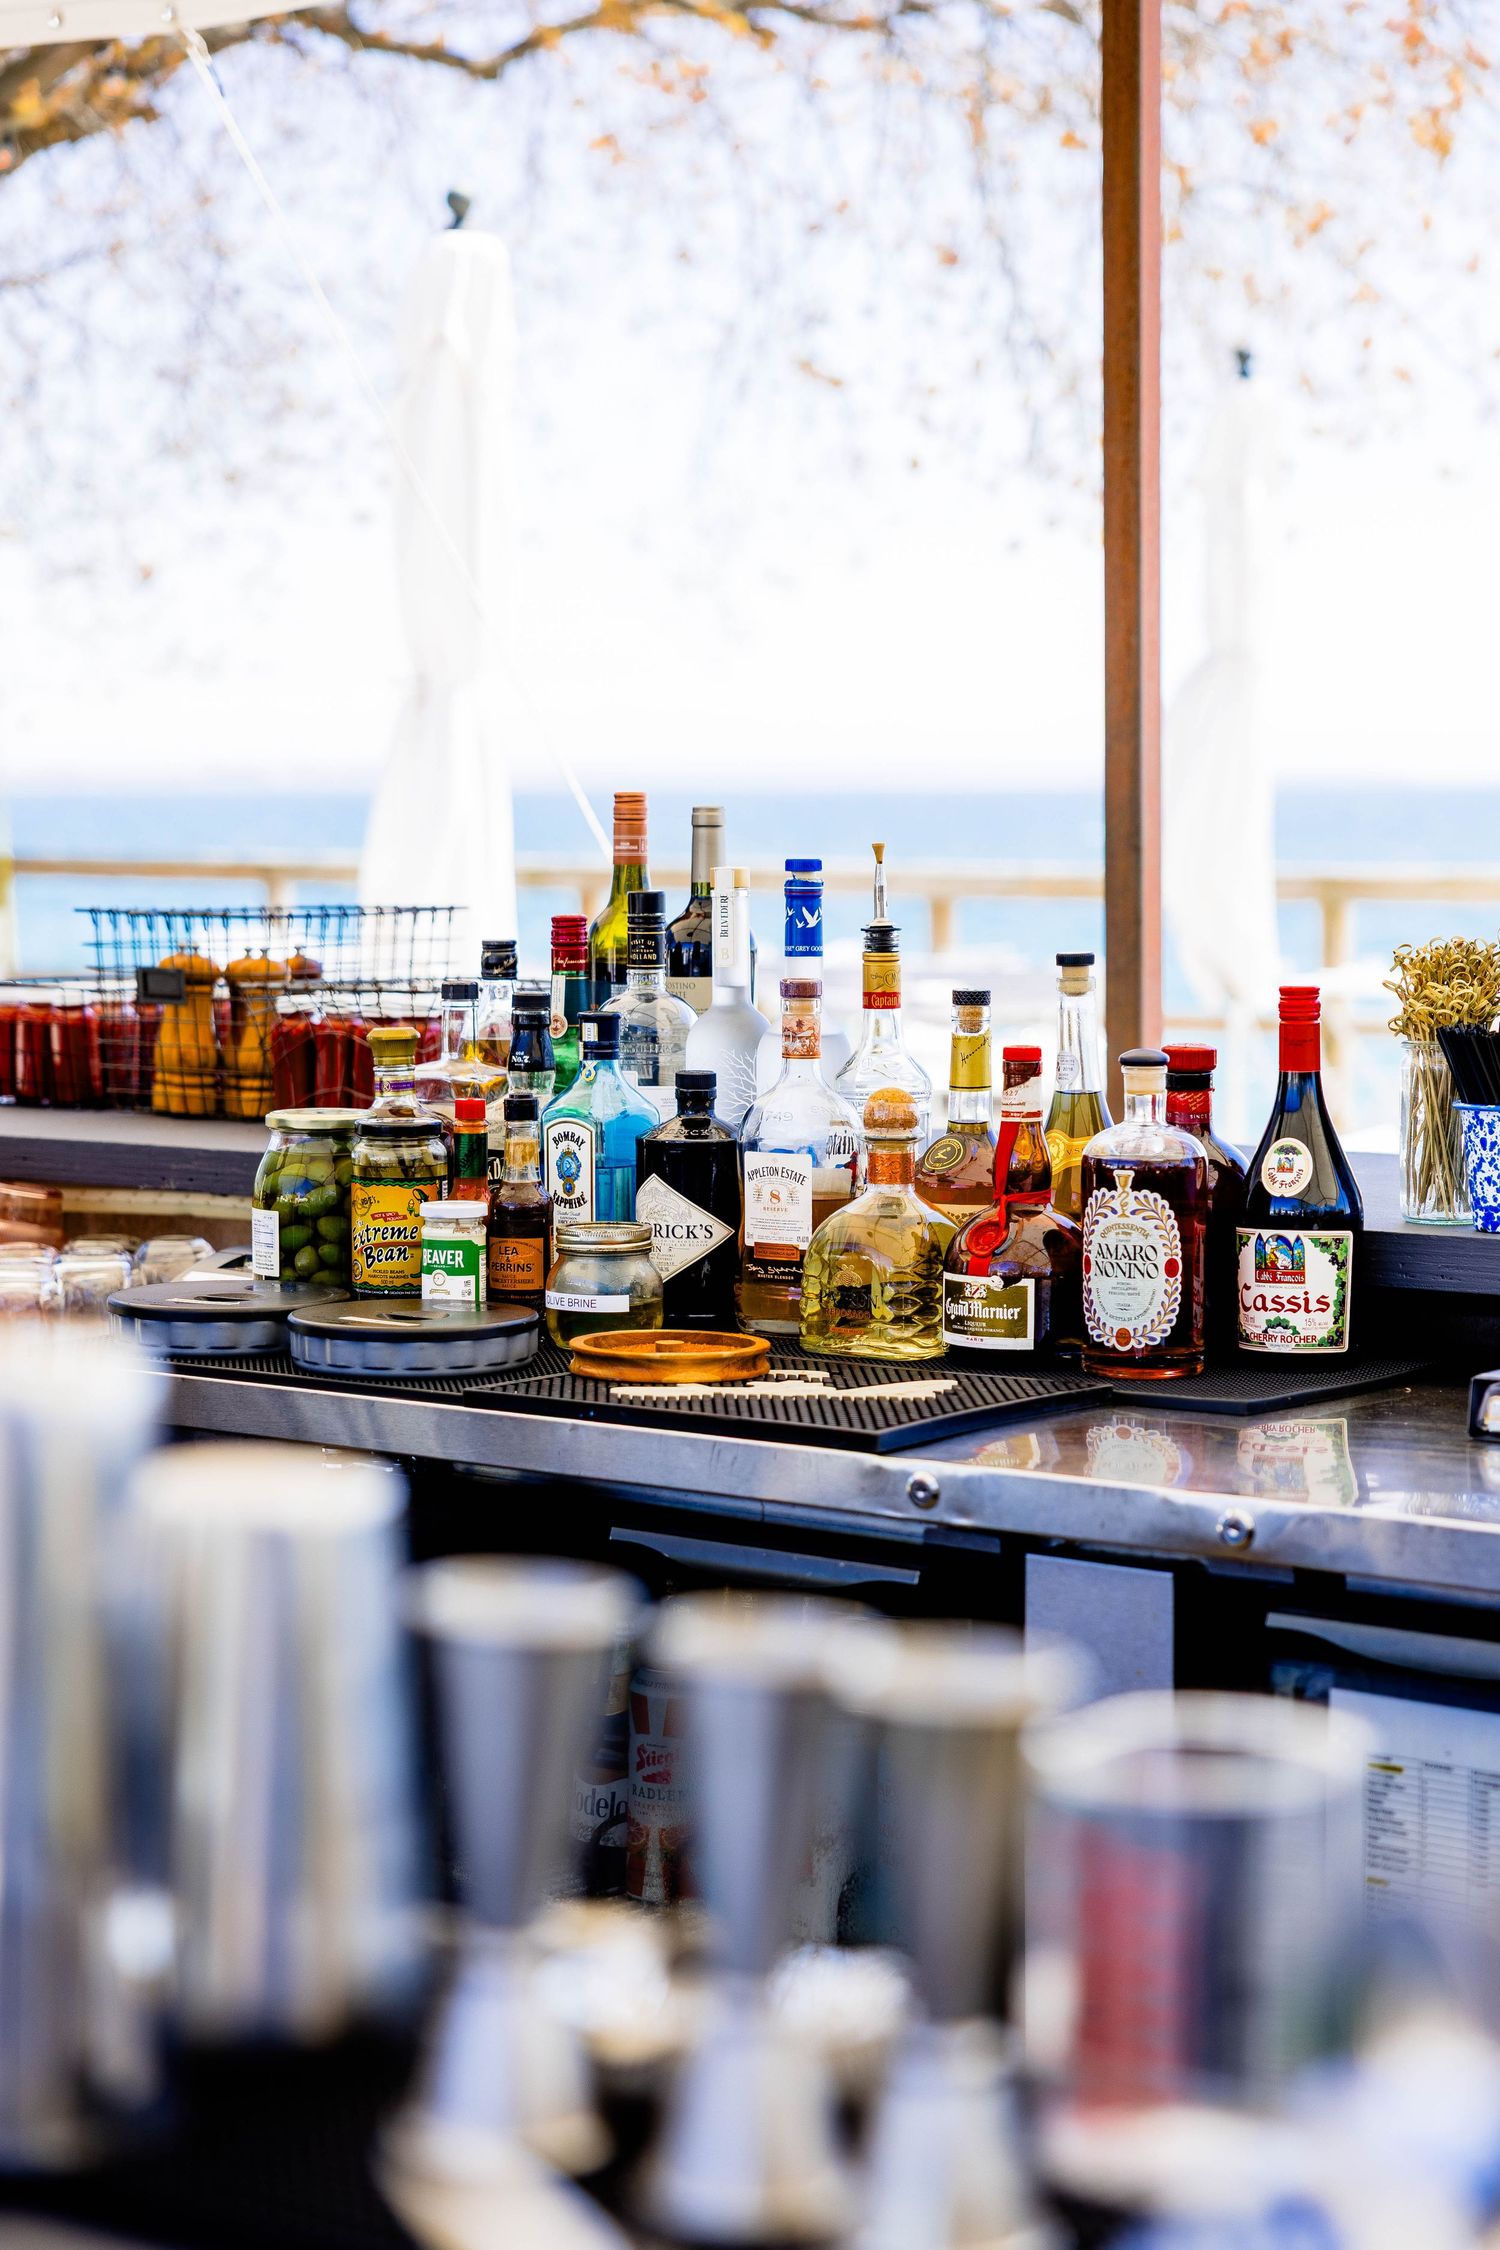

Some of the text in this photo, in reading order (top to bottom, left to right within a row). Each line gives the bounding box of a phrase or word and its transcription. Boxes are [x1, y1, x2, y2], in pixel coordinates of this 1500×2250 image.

[552, 1130, 586, 1150] BOMBAY
[747, 1166, 780, 1182] APPLETON
[780, 1167, 808, 1186] ESTATE
[553, 1189, 588, 1209] SAPPHIRE
[770, 1190, 781, 1204] 8
[352, 1224, 418, 1251] Extreme
[643, 1222, 714, 1240] RICK'S
[1100, 1222, 1151, 1240] QUINTESSENTIA
[363, 1245, 410, 1270] Bean
[422, 1248, 464, 1268] BEAVER
[498, 1246, 518, 1256] LEA
[1094, 1242, 1158, 1262] AMARO
[492, 1262, 532, 1272] PERRINS
[1094, 1260, 1160, 1280] NONINO
[1276, 1271, 1304, 1283] François
[546, 1294, 565, 1307] OLIVE
[567, 1298, 597, 1308] BRINE
[1240, 1282, 1330, 1314] Cassis
[946, 1298, 1022, 1320] Grand Marnier
[1249, 1332, 1318, 1344] CHERRY ROCHER
[576, 1788, 628, 1819] odelo
